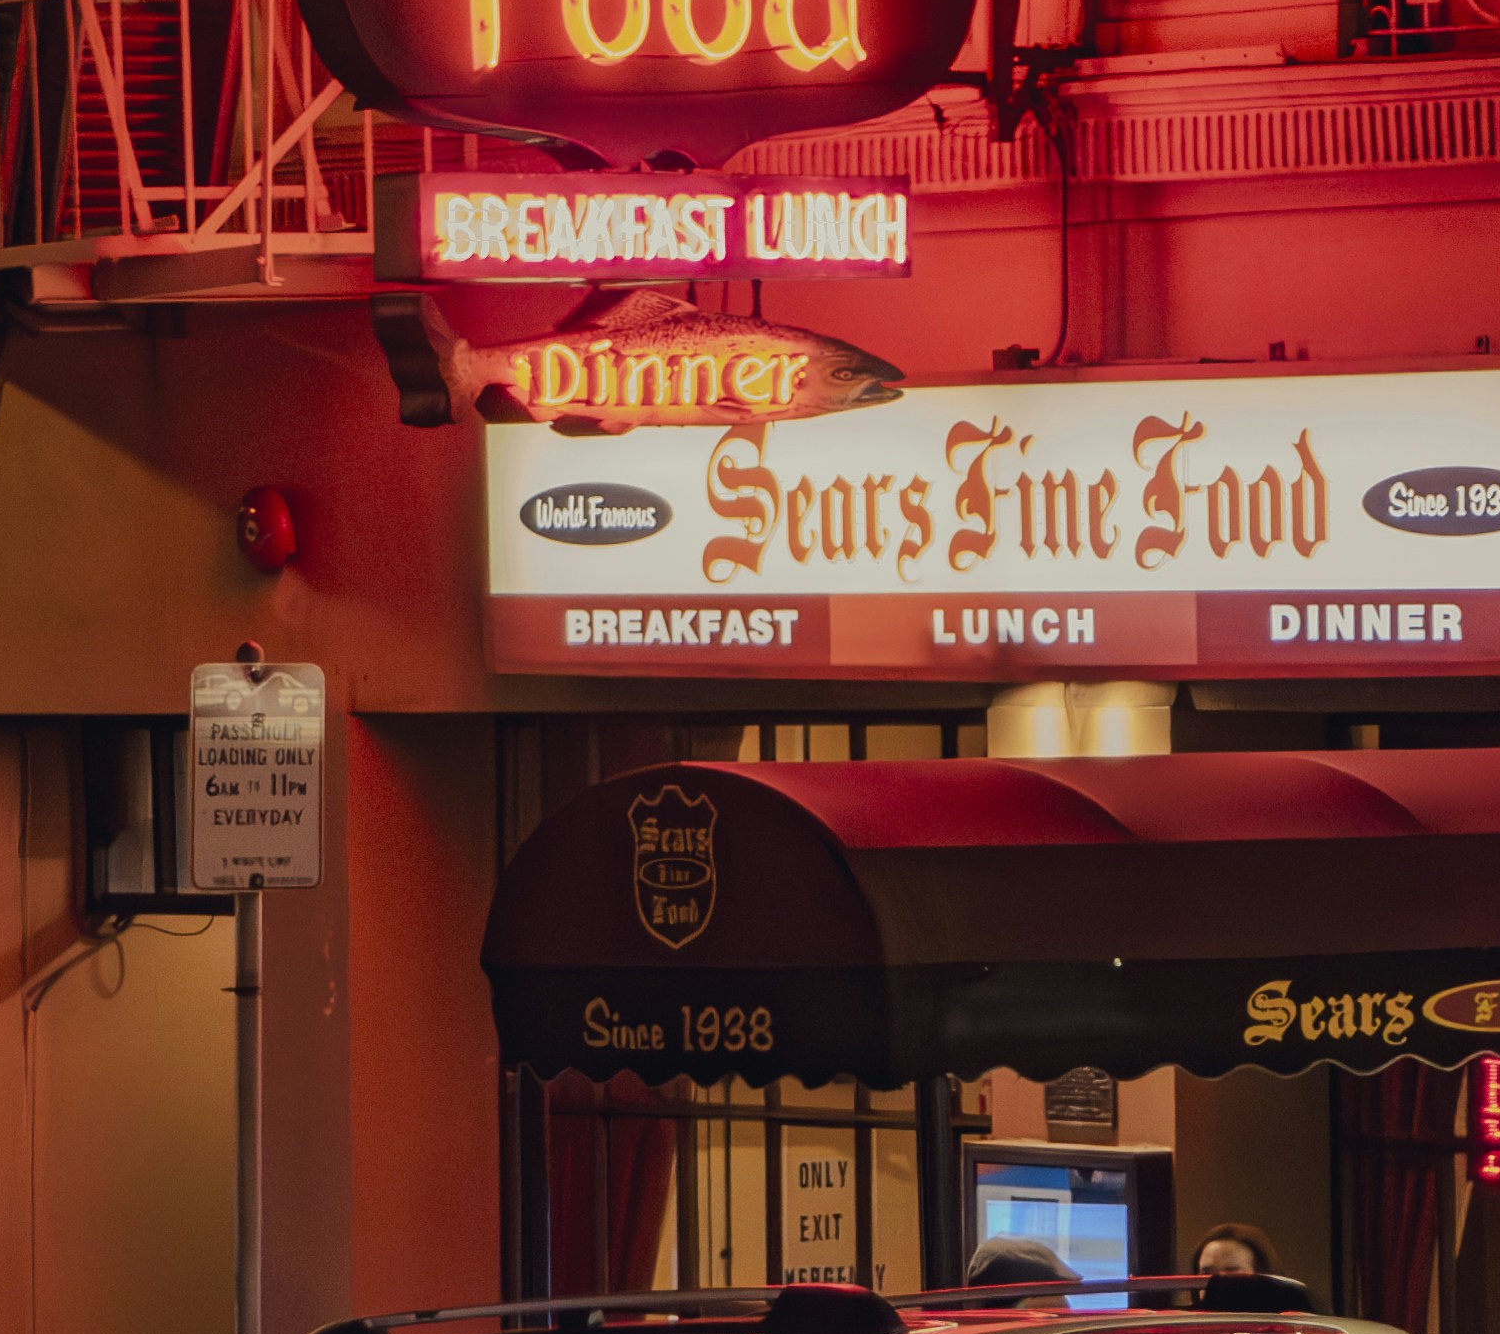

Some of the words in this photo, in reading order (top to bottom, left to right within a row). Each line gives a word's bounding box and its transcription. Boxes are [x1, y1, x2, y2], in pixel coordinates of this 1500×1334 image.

[434, 192, 736, 264] BREAKFAST
[746, 192, 910, 264] LUNCH
[516, 340, 809, 409] Dinner
[535, 495, 587, 531] World
[588, 495, 658, 531] Famous
[701, 422, 936, 585] Sears
[944, 414, 1122, 574] Fine
[1131, 409, 1333, 571] Food
[1387, 482, 1450, 518] Since
[565, 608, 800, 646] BREAKFAST
[931, 607, 1097, 646] LUNCH
[1269, 603, 1464, 643] DINNER
[197, 747, 268, 767] LOADING
[275, 747, 315, 767] ONLY
[205, 772, 240, 797] 6AM
[270, 772, 308, 797] 11PM
[213, 807, 304, 827] EVERYDAY
[638, 816, 709, 858] Sears
[583, 996, 666, 1051] Since
[681, 1004, 775, 1053] 1938
[1242, 979, 1416, 1047] Sears
[799, 1160, 848, 1190] ONLY
[799, 1212, 843, 1243] EXIT
